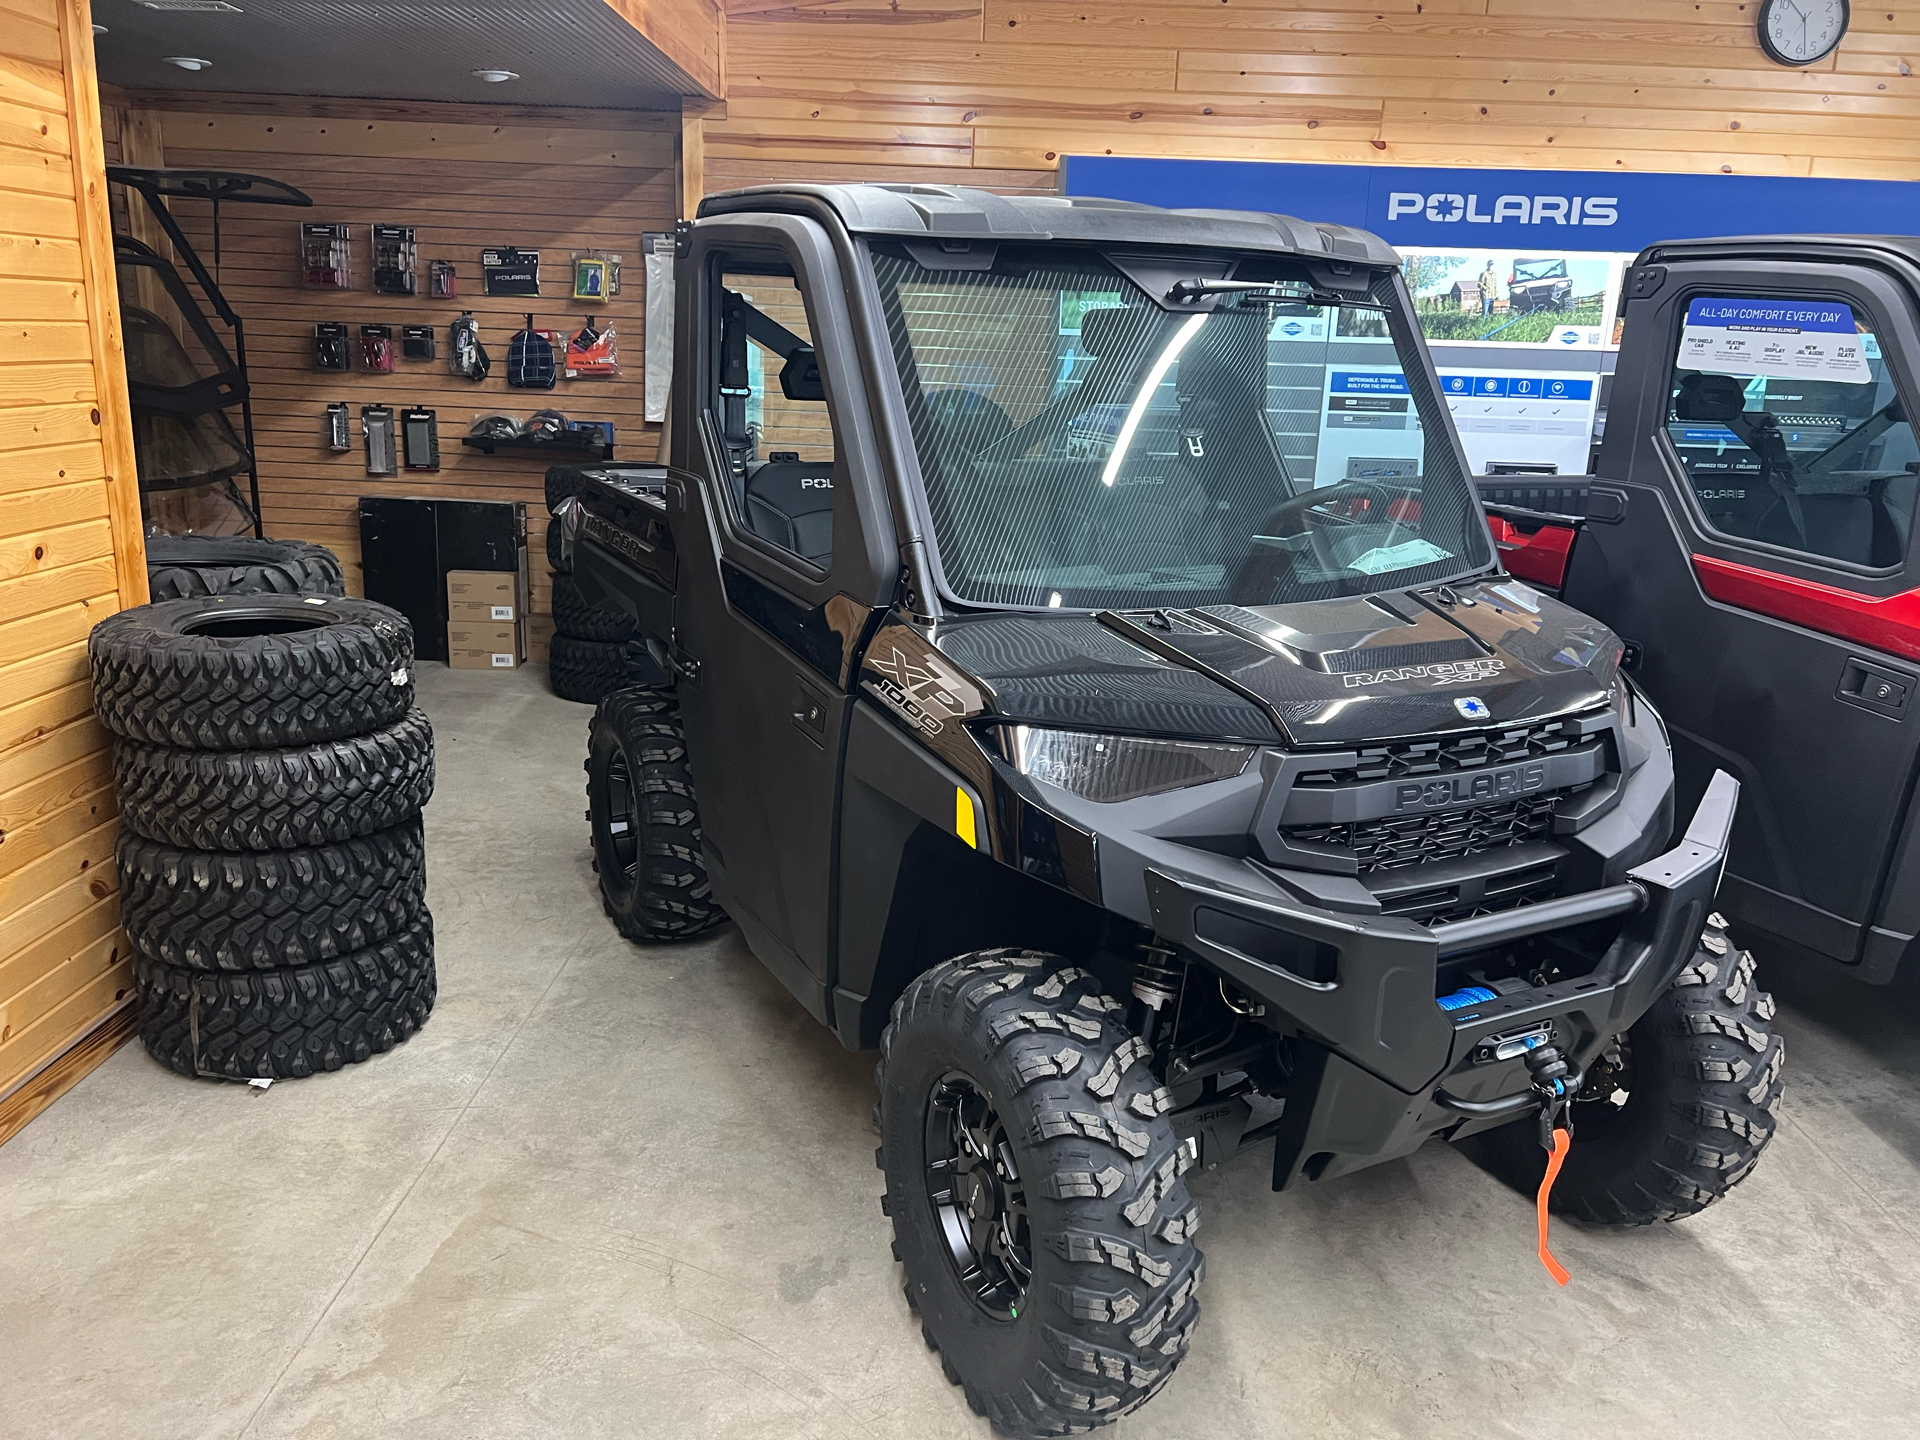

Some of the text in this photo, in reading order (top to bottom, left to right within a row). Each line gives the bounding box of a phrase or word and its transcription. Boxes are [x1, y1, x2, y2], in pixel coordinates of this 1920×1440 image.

[1825, 2, 1833, 13] 2
[1774, 14, 1782, 25] 9
[1826, 16, 1834, 27] 3
[1775, 27, 1783, 39] 8
[1820, 31, 1827, 41] 4
[1783, 40, 1791, 50] 7
[1795, 43, 1803, 55] 6
[1809, 41, 1817, 52] 5
[1388, 192, 1618, 226] POLARIS
[1699, 307, 1842, 323] ALL-DAY COMFORT EVERY DAY
[801, 478, 834, 489] POL
[584, 515, 641, 560] RANGER
[1343, 659, 1507, 688] RANGER
[1431, 670, 1500, 686] XP
[868, 646, 966, 716] XP
[879, 679, 944, 735] 1000
[876, 691, 935, 740] DUAL OVERHEAD CAM
[1395, 764, 1544, 811] POLARIS
